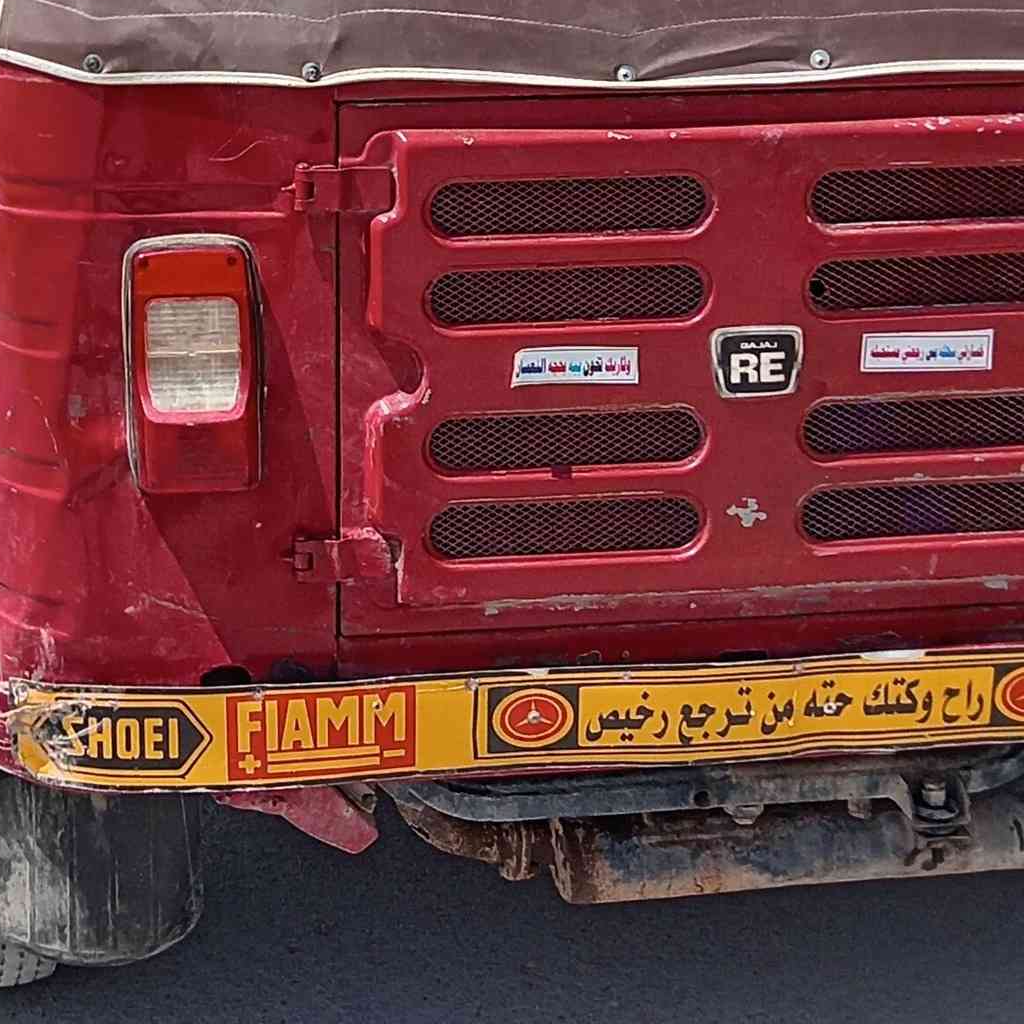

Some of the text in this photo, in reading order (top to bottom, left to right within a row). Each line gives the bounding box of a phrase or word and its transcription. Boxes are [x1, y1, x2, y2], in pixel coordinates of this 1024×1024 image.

[730, 352, 786, 384] RE
[236, 691, 407, 753] FIAMM
[585, 689, 668, 742] رخيص
[678, 686, 753, 745] ترجع
[760, 691, 795, 735] من
[863, 676, 933, 723] وكتك
[942, 679, 985, 723] راح
[62, 713, 180, 761] SHOEI
